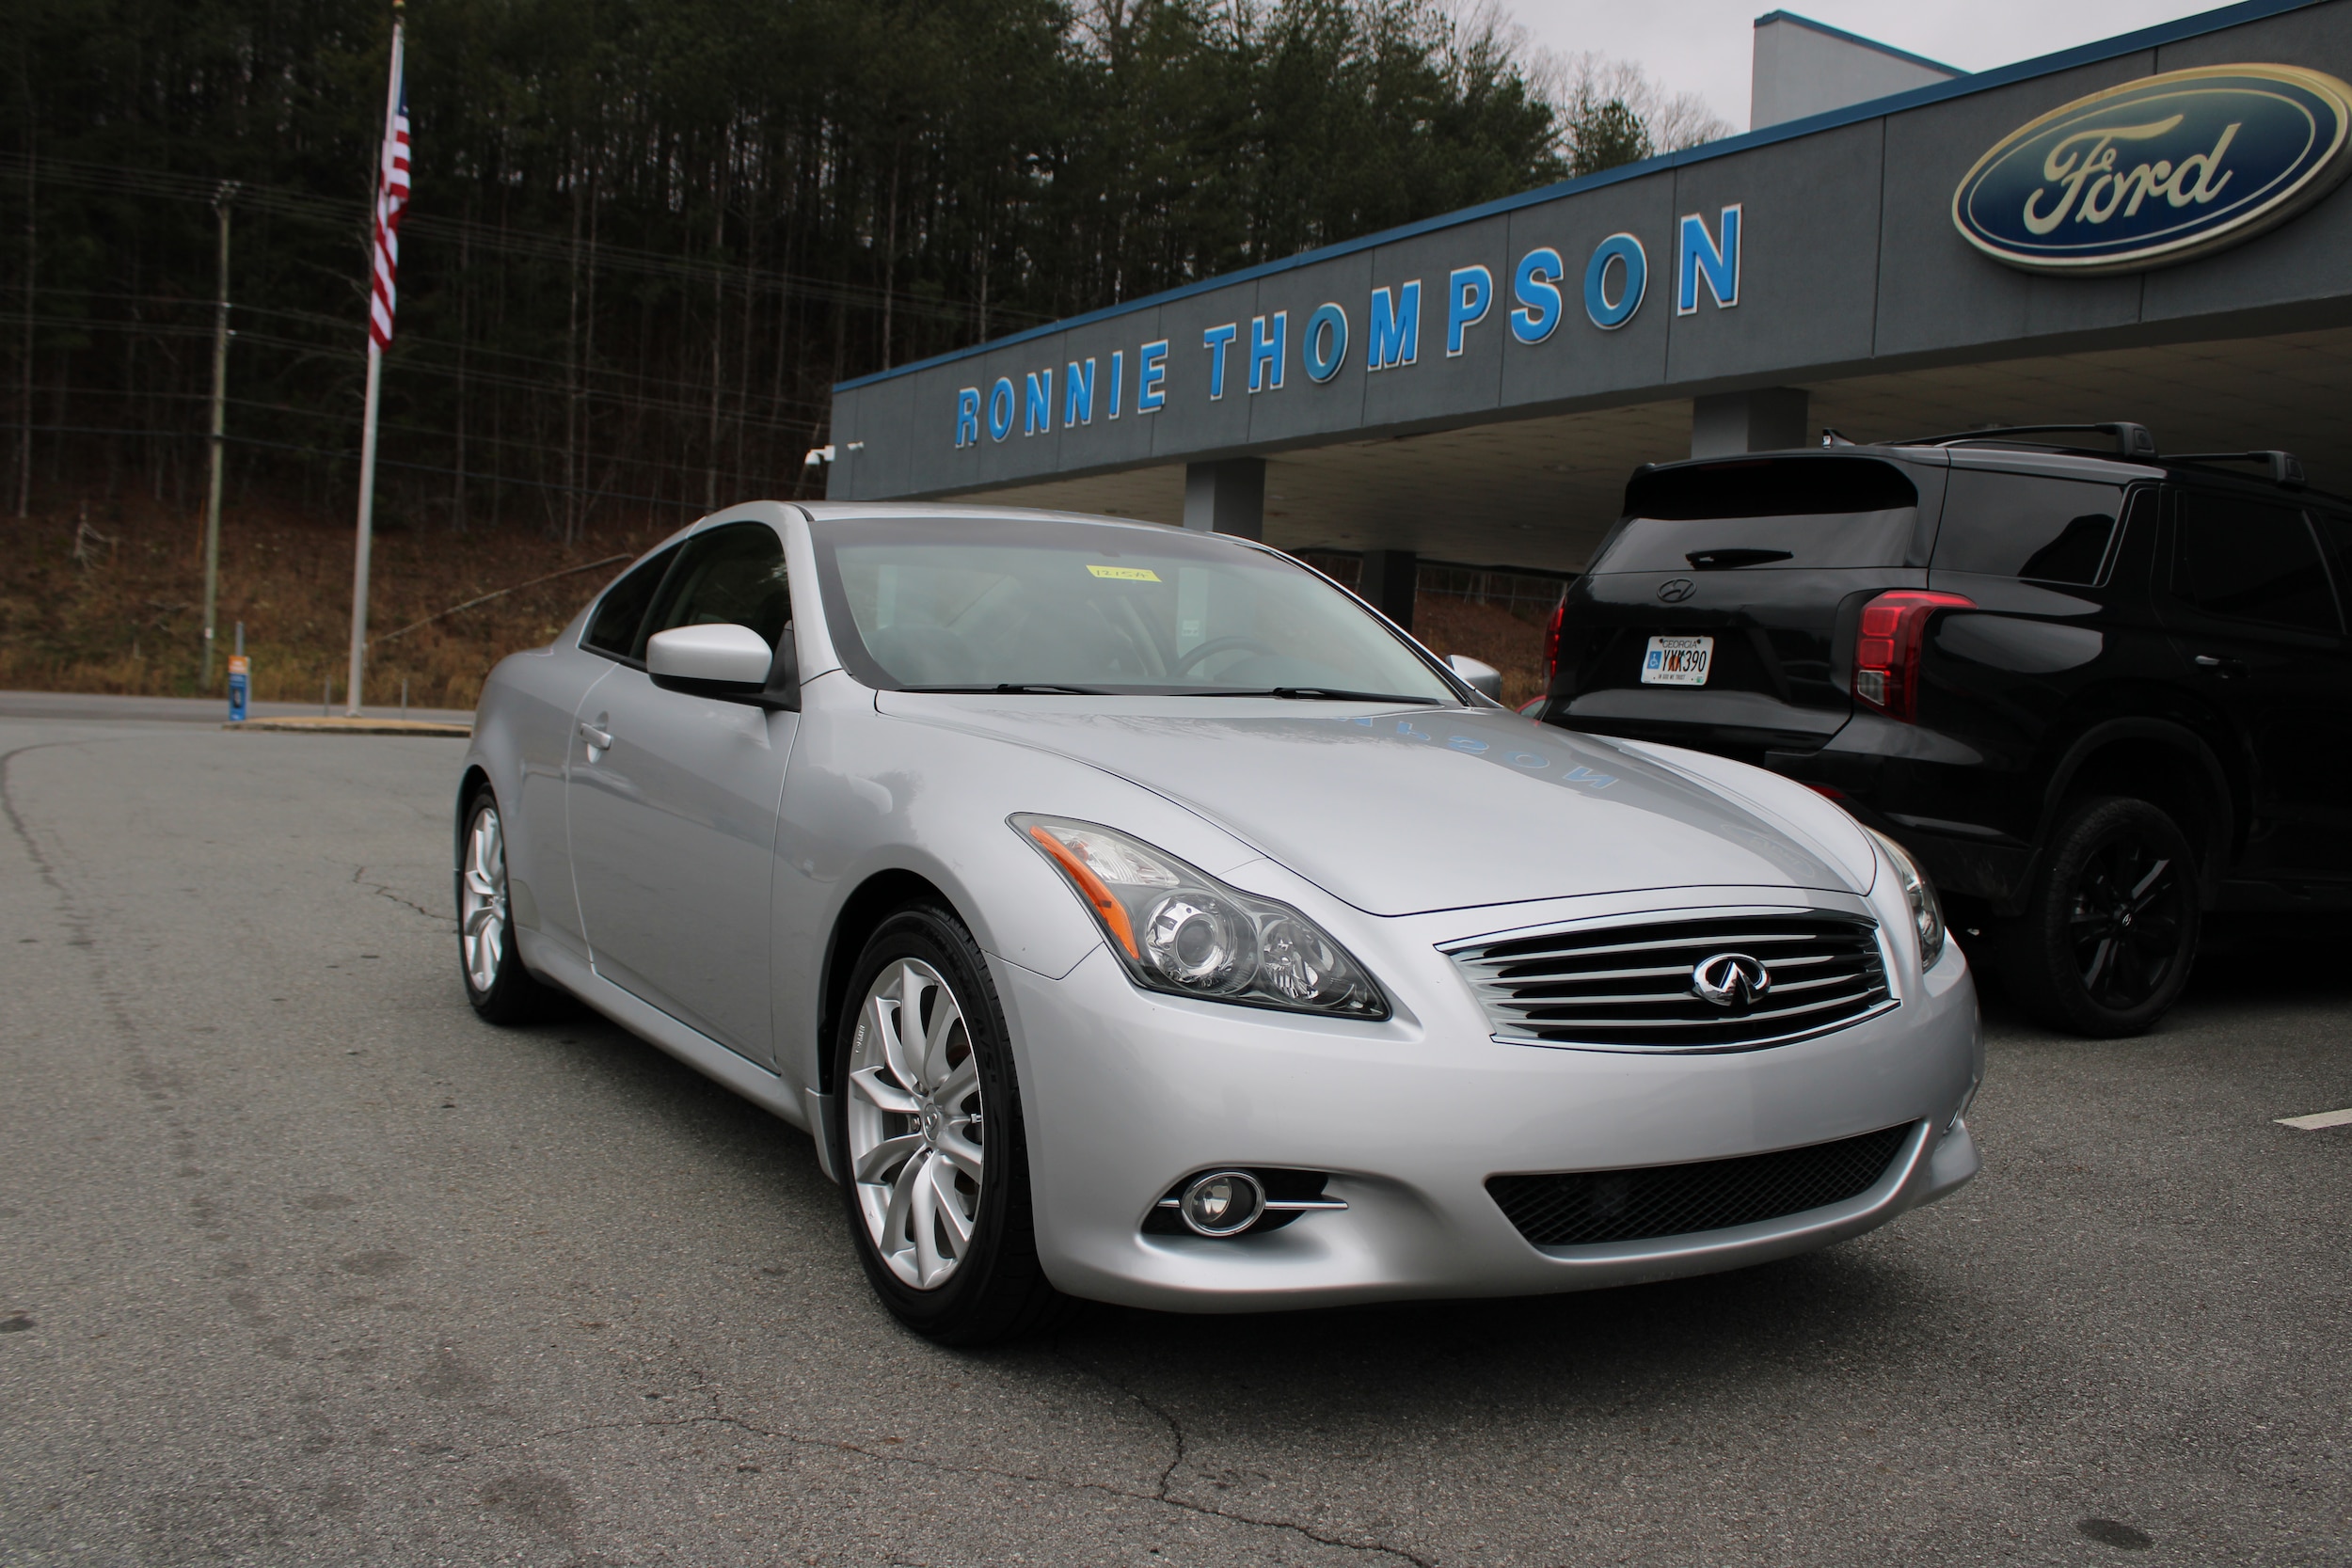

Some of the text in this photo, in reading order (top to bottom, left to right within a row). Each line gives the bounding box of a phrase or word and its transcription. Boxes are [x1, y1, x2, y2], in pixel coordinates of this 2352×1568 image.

[2024, 114, 2242, 234] Ford
[955, 203, 1742, 449] RONNIE THOMPSON
[1661, 640, 1697, 649] GEORGIA
[1662, 649, 1707, 673] YXK390
